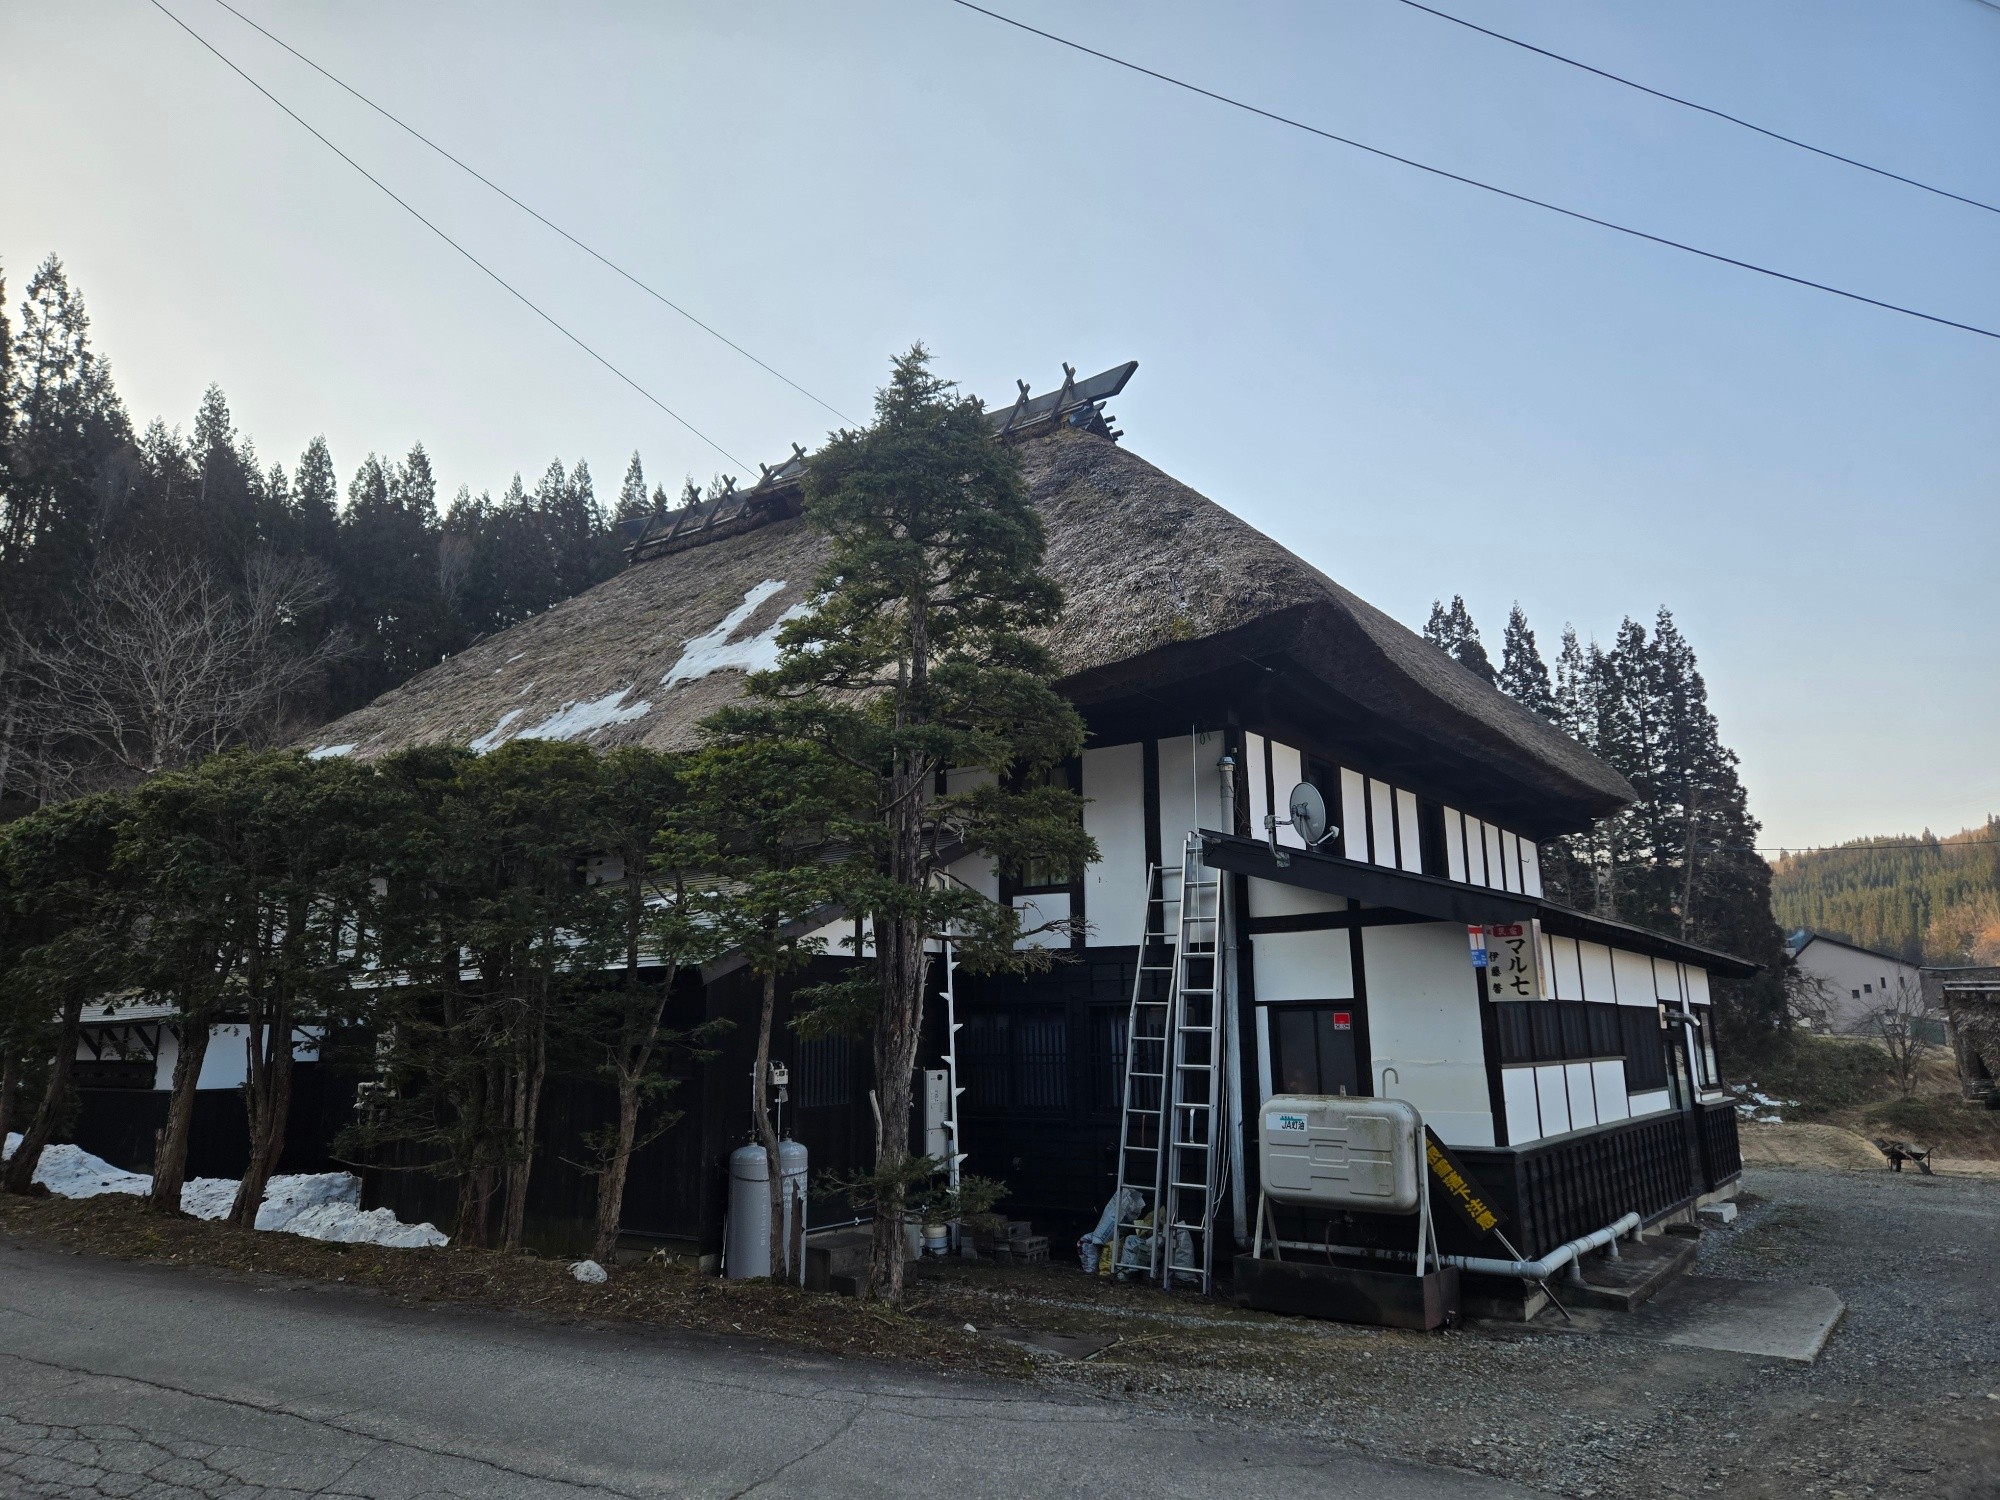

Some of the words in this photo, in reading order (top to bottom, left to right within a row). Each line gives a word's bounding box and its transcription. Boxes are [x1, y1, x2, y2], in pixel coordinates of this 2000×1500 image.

[1505, 938, 1530, 996] マル七
[1282, 1120, 1304, 1131] JA灯油
[1426, 1138, 1498, 1231] 根雪落下注意
